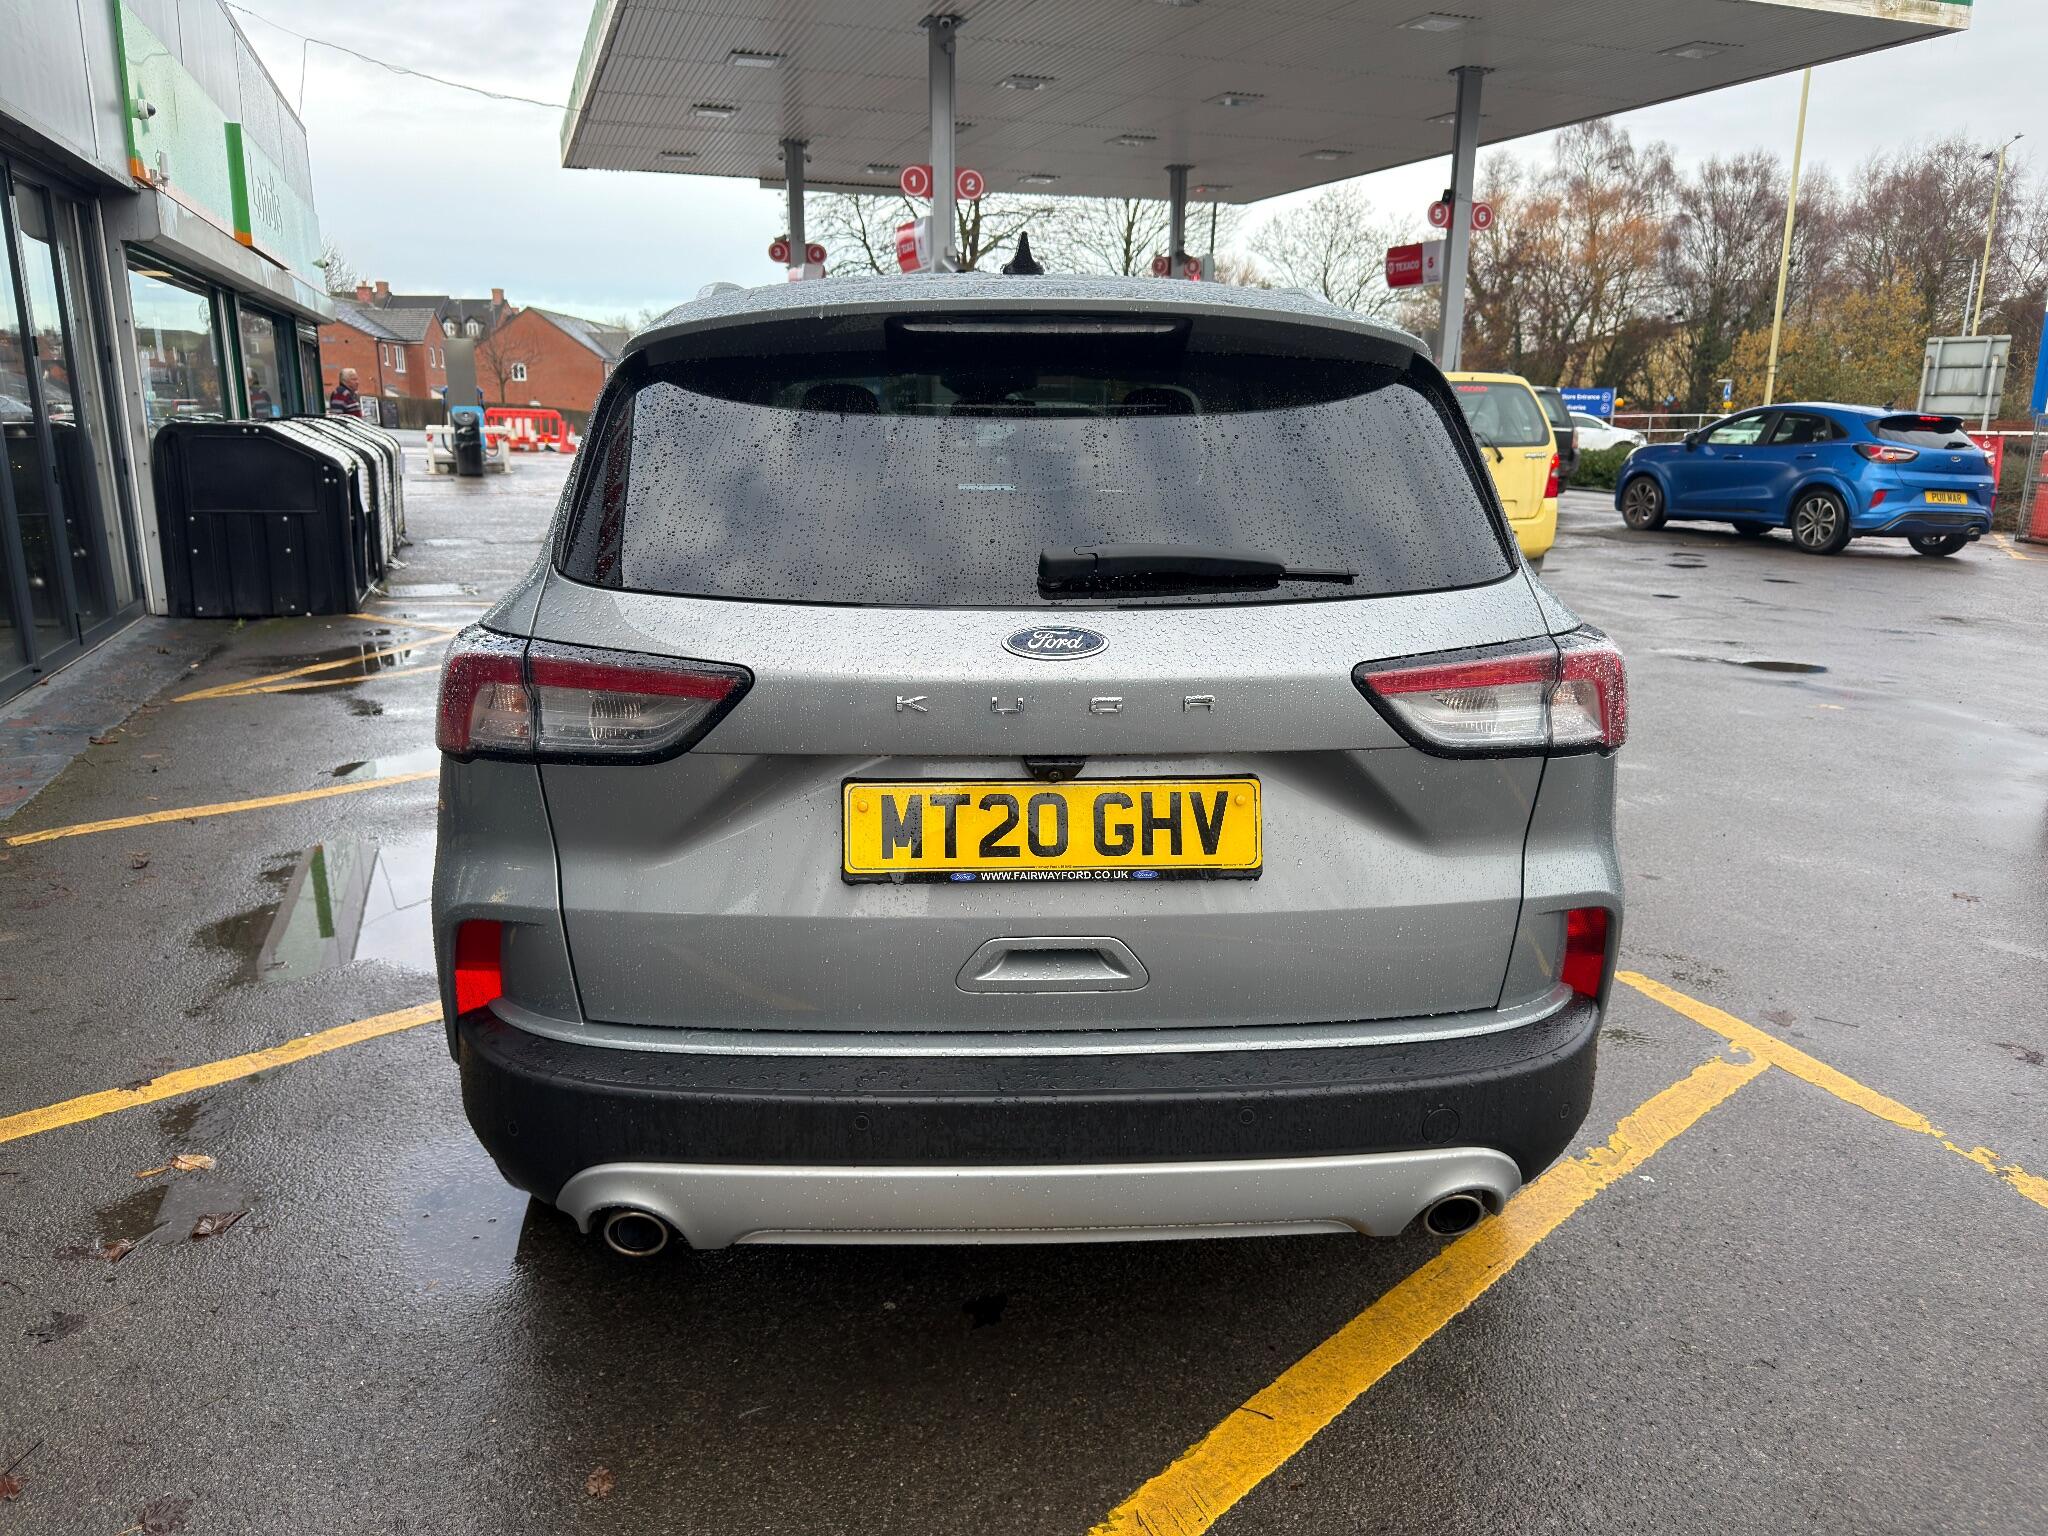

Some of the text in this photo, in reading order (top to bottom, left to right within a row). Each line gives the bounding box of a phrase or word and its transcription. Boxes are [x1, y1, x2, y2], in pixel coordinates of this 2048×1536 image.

[966, 178, 975, 190] 2
[1027, 630, 1084, 649] Ford
[896, 694, 1215, 713] KUGA
[881, 791, 1229, 860] MT20 GHV
[980, 870, 1129, 882] WWW.FAIRWAYFORD.CO.UK
